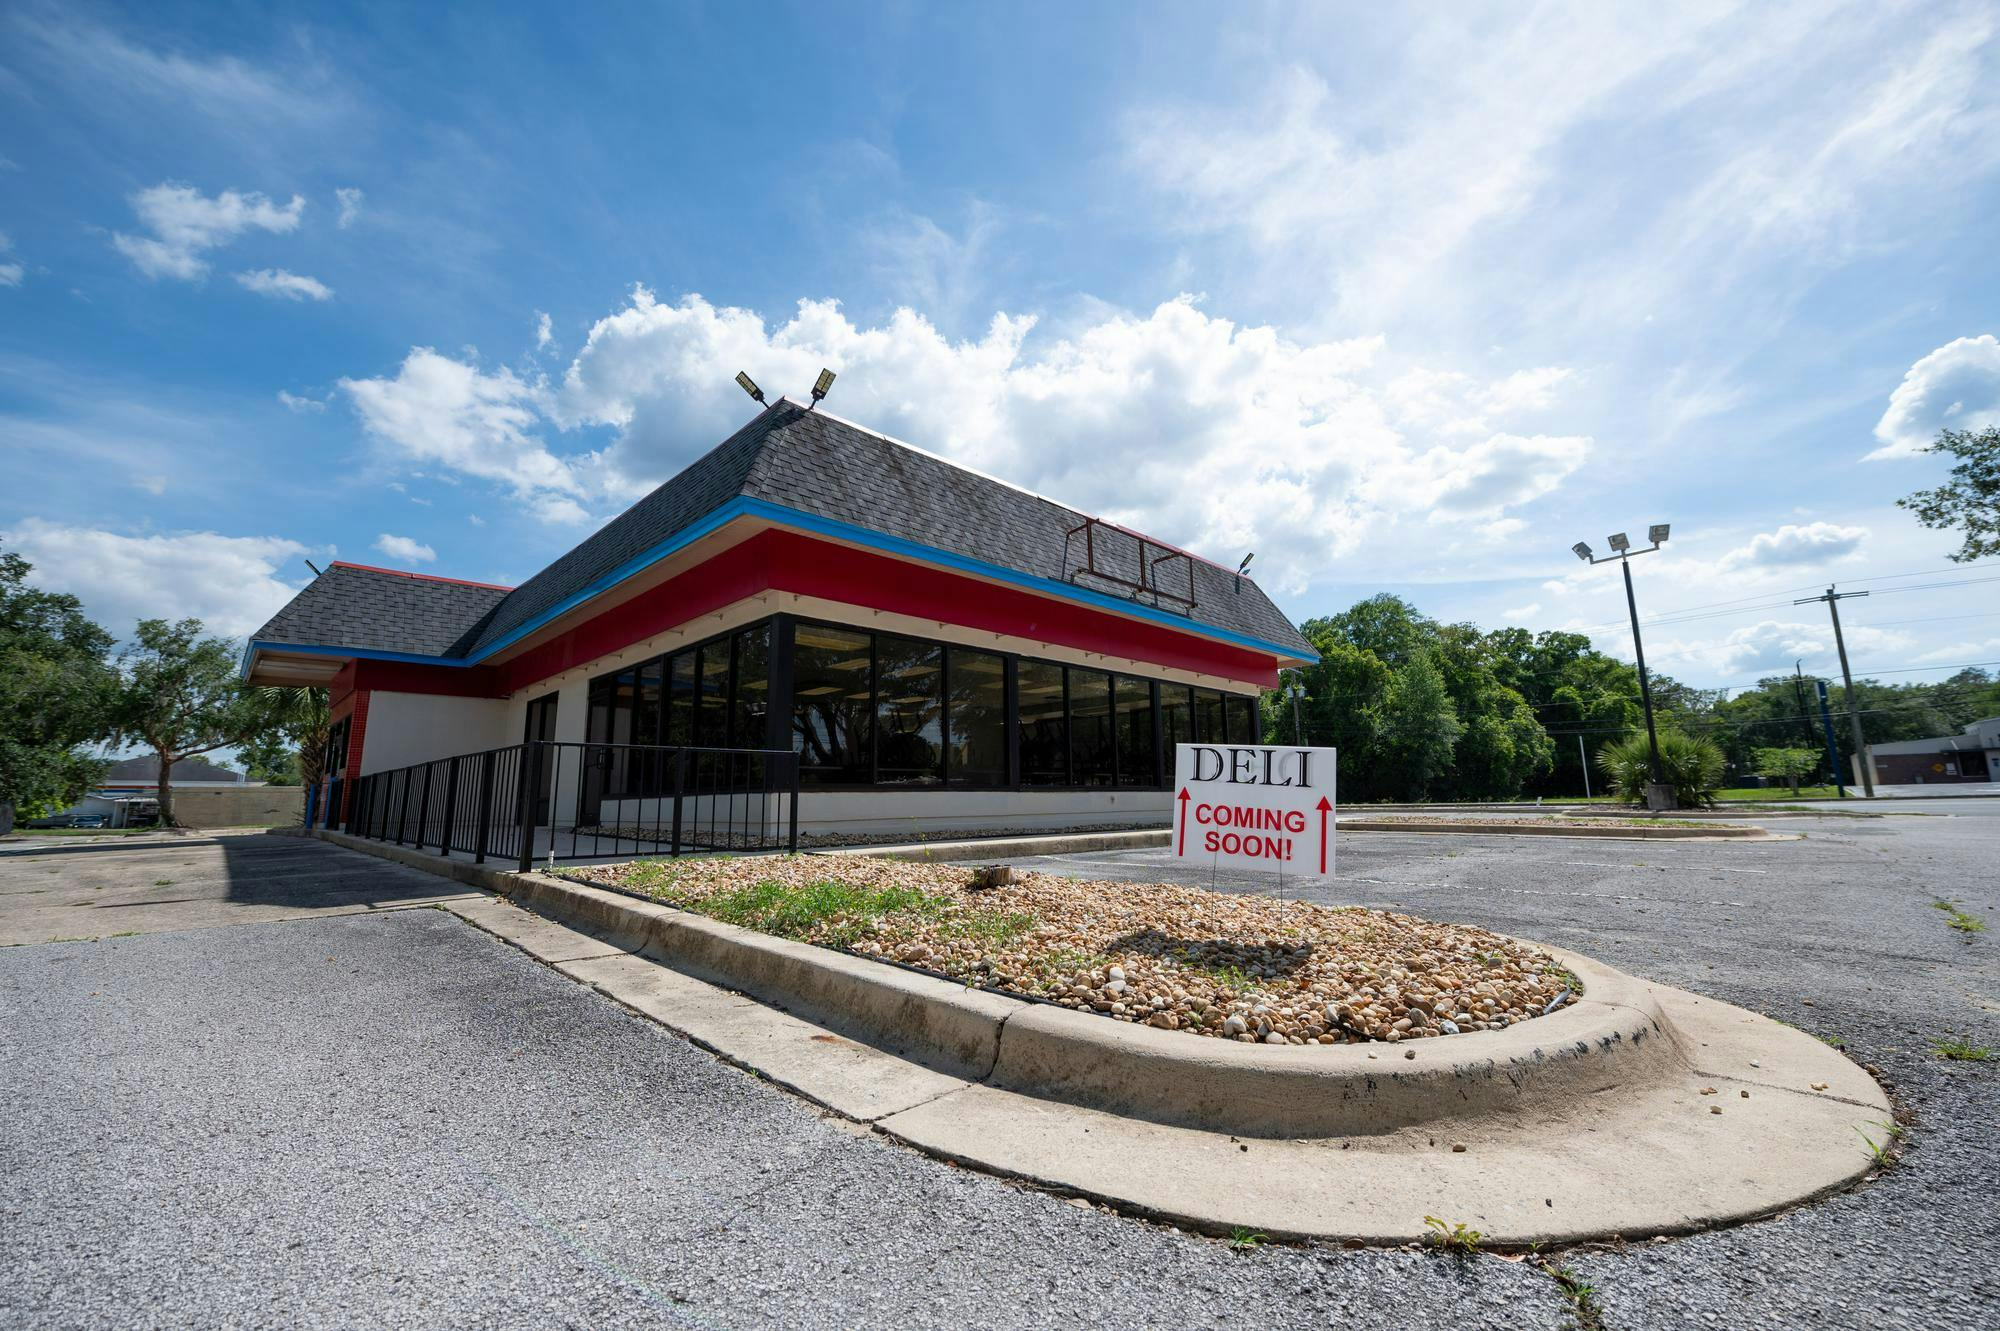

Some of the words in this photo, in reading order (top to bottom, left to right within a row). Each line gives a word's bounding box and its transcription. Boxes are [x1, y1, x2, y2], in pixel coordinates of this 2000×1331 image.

[1190, 747, 1312, 788] DELI
[1195, 803, 1305, 833] COMING
[1204, 831, 1292, 861] SOON!
